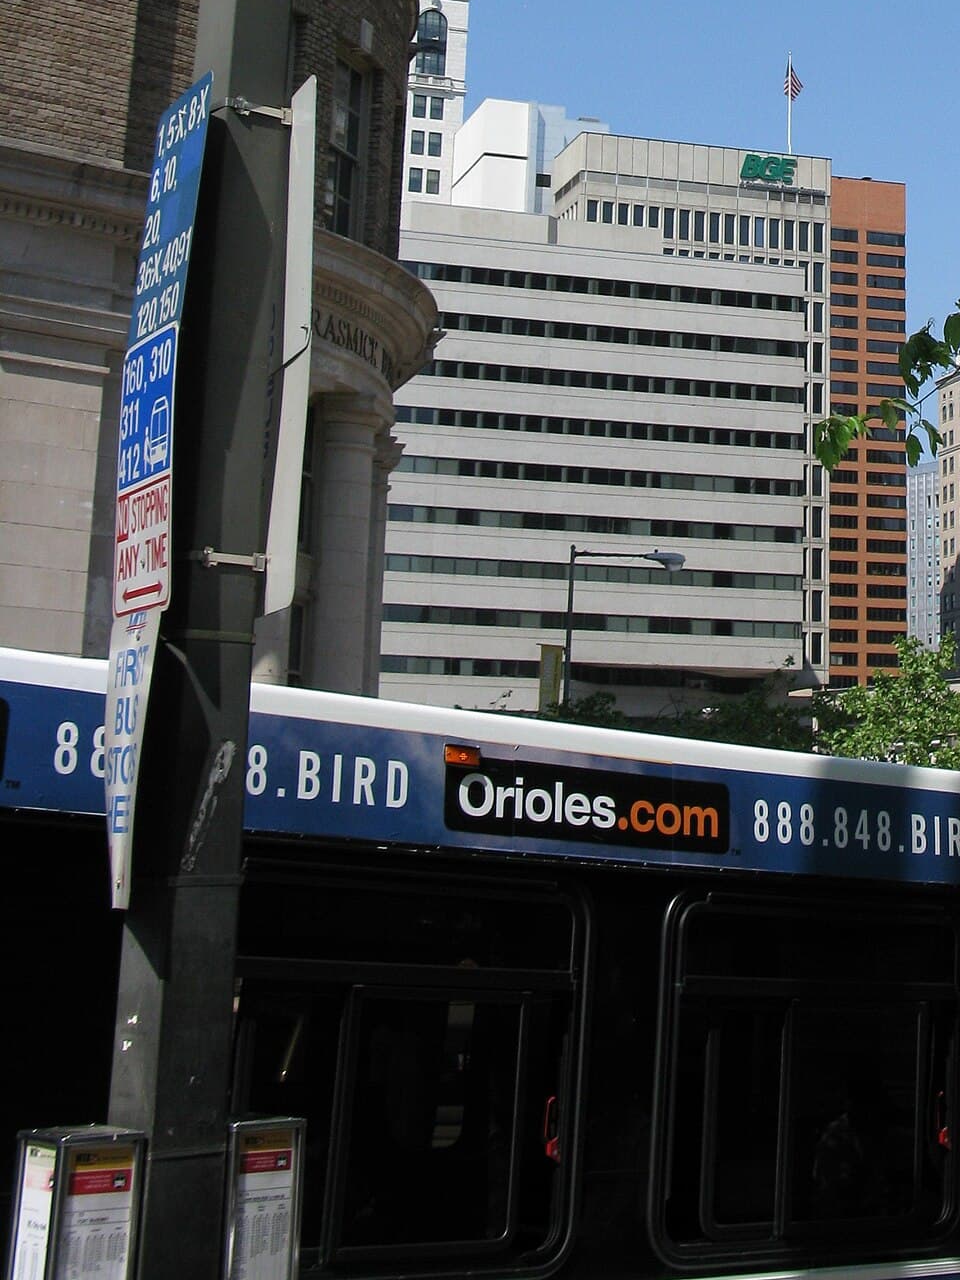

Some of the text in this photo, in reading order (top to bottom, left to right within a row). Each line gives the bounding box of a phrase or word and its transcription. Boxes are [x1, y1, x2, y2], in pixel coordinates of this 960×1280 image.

[163, 155, 177, 193] 10,
[740, 154, 797, 185] BGE
[142, 210, 160, 249] 20,
[149, 338, 172, 383] 310
[121, 398, 140, 441] 311
[118, 443, 141, 484] 412
[117, 484, 168, 541] NO STOPPING
[117, 532, 168, 582] ANY TIME
[458, 772, 719, 838] Orioles.com
